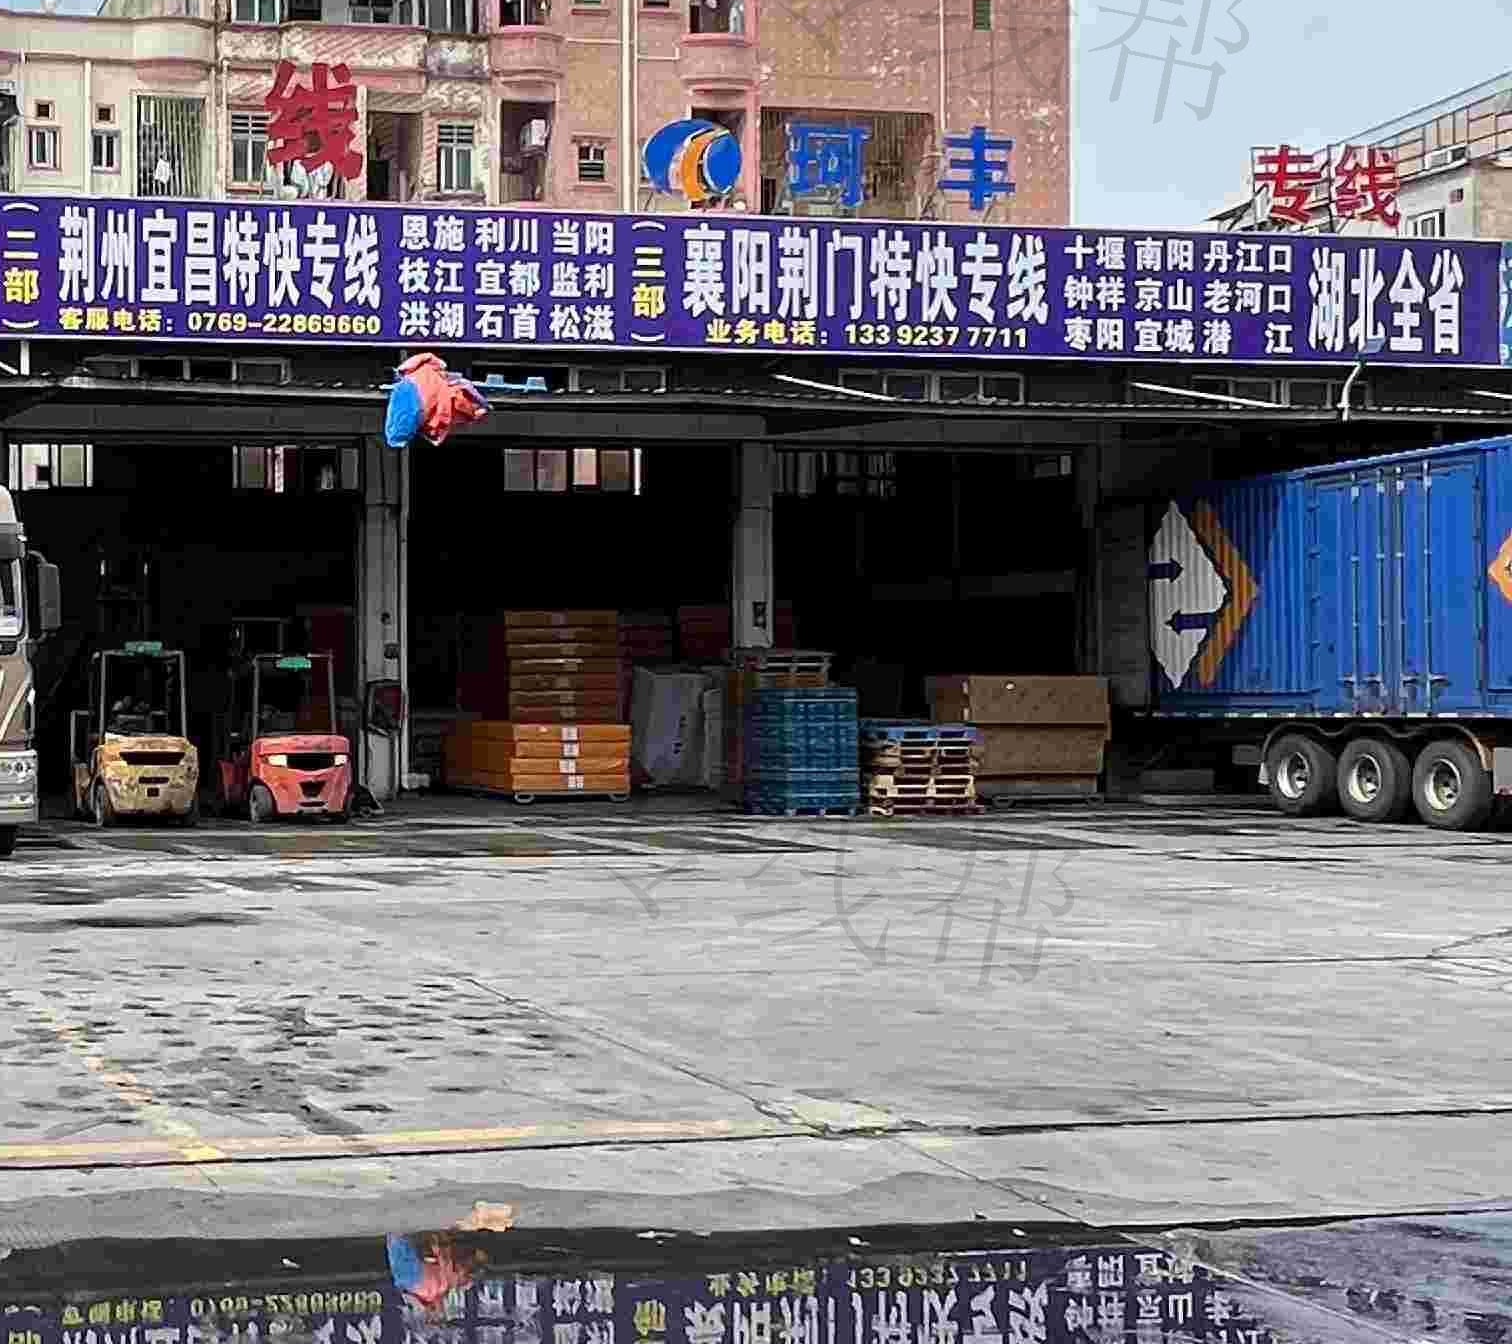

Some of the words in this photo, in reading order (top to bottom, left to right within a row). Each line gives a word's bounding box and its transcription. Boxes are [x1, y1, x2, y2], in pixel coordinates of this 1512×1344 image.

[1254, 144, 1402, 230] 专线
[398, 213, 467, 256] 恩施
[474, 216, 540, 256] 利川
[550, 219, 616, 257] 当阳
[1063, 236, 1127, 273] 十堰
[1133, 237, 1195, 273] 南阳
[1203, 239, 1294, 274] 丹江口
[58, 204, 382, 311] 荆州宜昌特快专线
[398, 256, 466, 296] 枝江
[474, 258, 542, 299] 宜都
[550, 261, 616, 300] 监利
[682, 223, 1050, 325] 襄阳荆门特快专线
[1063, 275, 1127, 312] 钟祥
[1133, 277, 1194, 314] 京山
[1203, 278, 1293, 315] 老河口
[1308, 247, 1464, 355] 湖北全省
[187, 311, 381, 337] 0769-22869660
[398, 299, 466, 339] 洪湖
[474, 301, 542, 341] 石首
[550, 303, 616, 343] 松滋
[845, 324, 891, 347] 133
[896, 325, 959, 348] 9237
[966, 326, 1028, 349] 7711
[1063, 316, 1126, 352] 枣阳
[1133, 318, 1194, 353] 宜城
